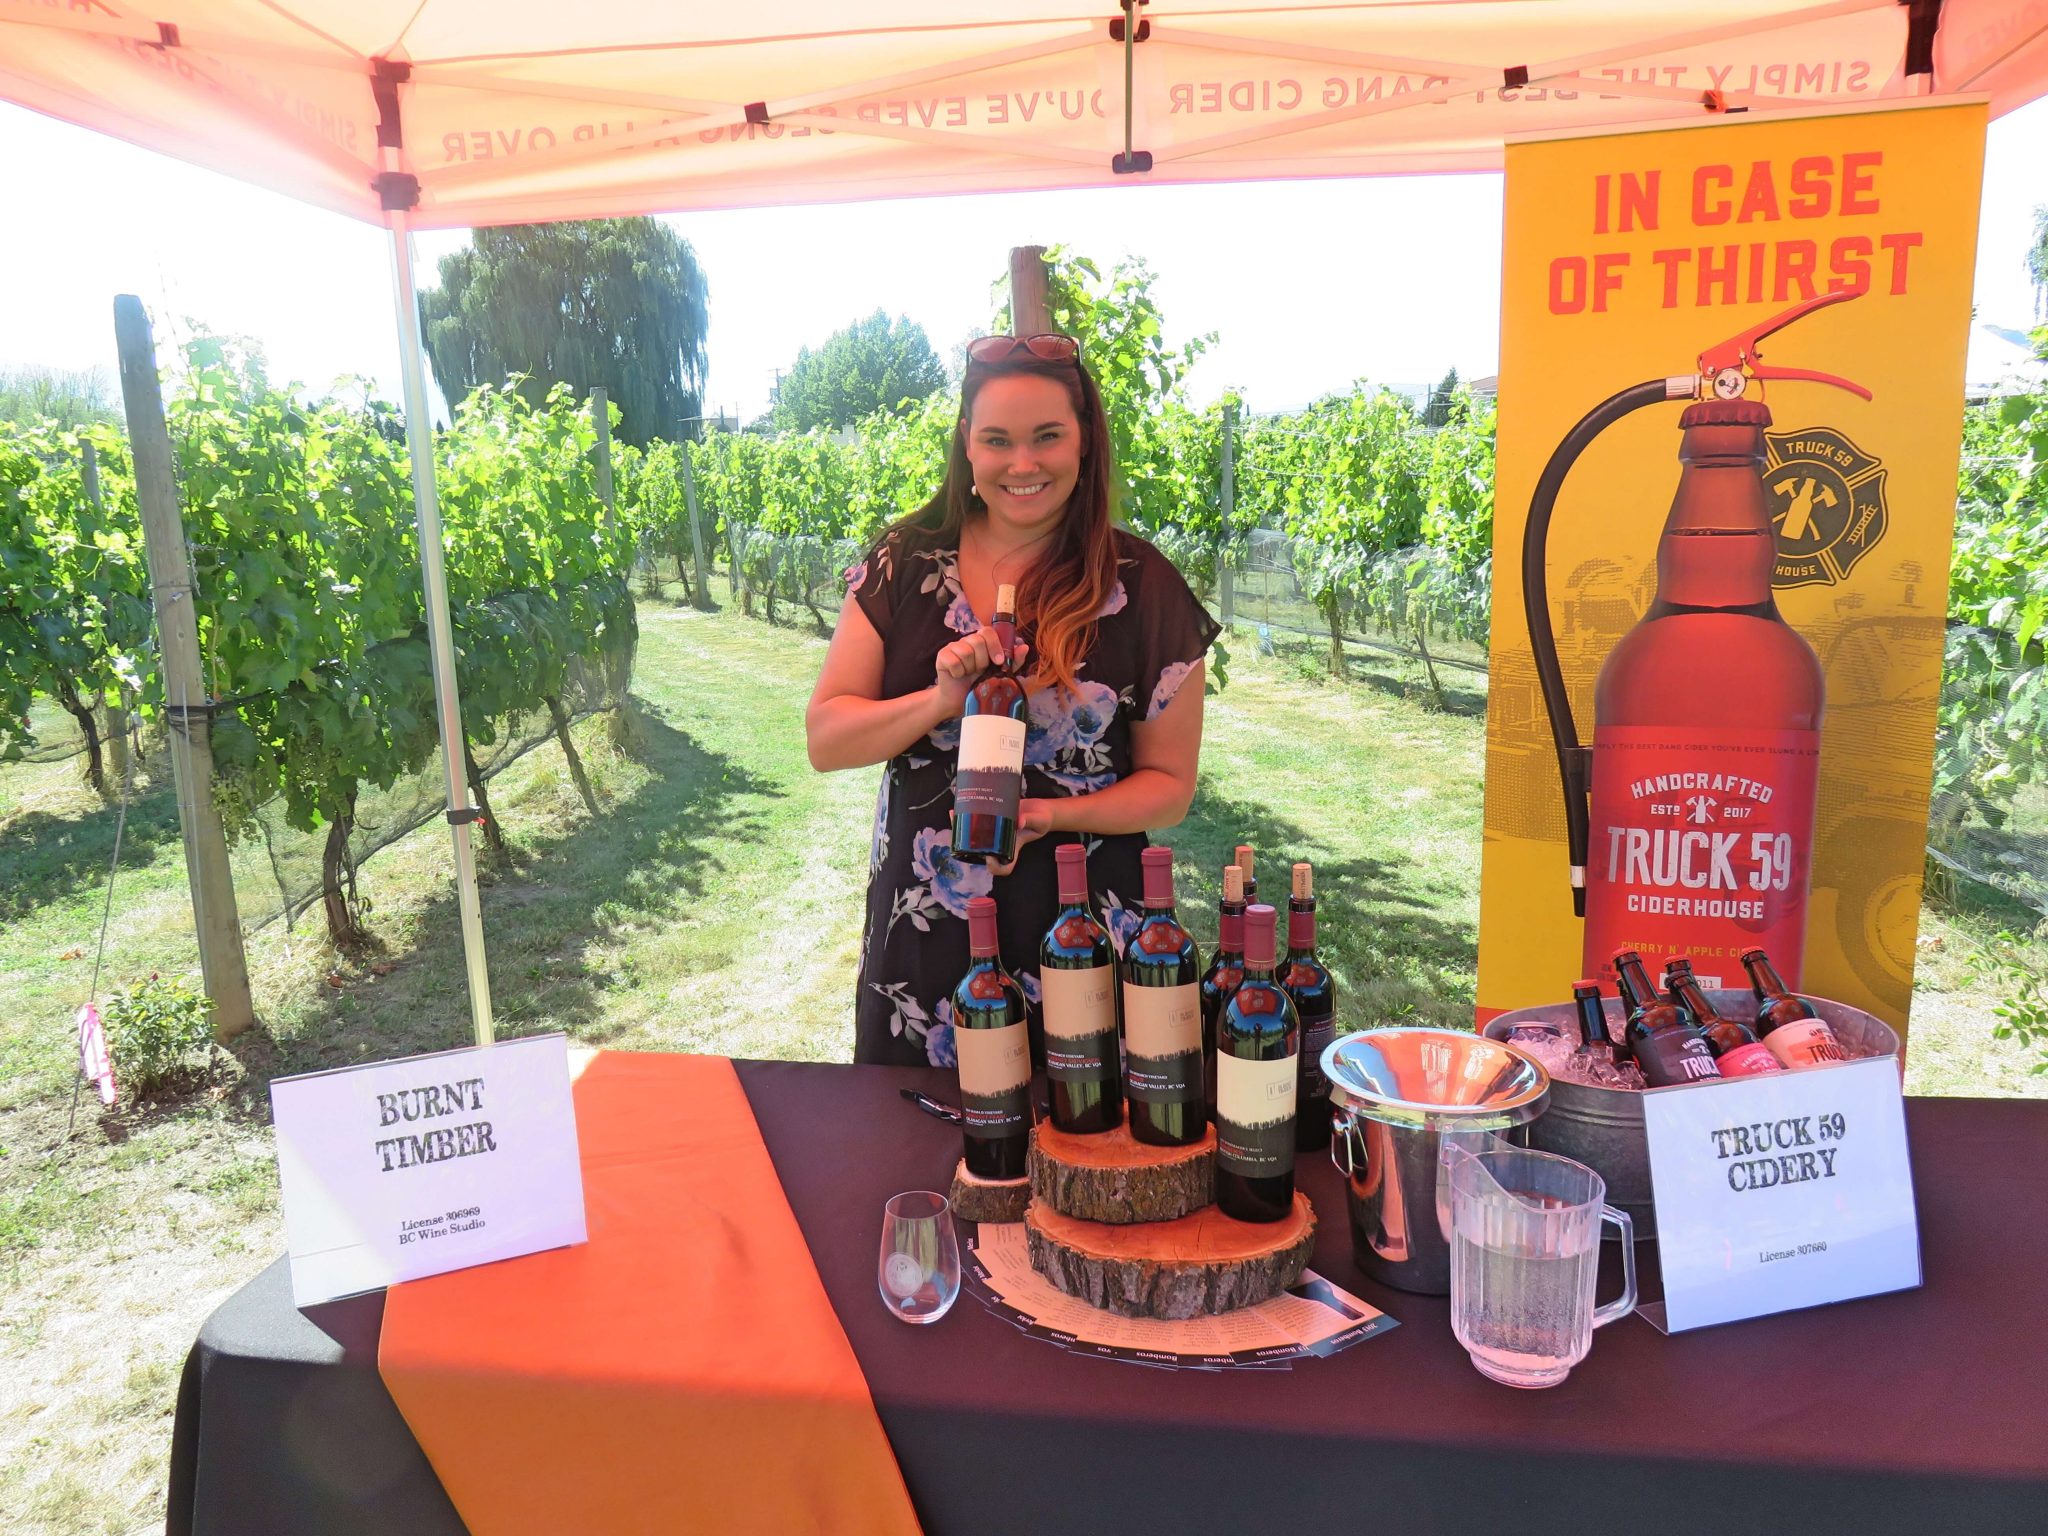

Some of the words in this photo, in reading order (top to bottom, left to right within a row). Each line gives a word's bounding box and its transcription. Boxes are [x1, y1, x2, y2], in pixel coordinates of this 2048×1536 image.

[1593, 170, 1661, 234] IN
[1691, 151, 1883, 227] CASE
[1548, 252, 1631, 316] OF
[1652, 232, 1923, 308] THIRST
[1785, 441, 1836, 458] TRUCK
[1833, 449, 1854, 467] 59
[1775, 564, 1817, 577] HOUSE
[1631, 772, 1774, 804] HANDCRAFTED
[1723, 807, 1752, 818] 2017
[1607, 826, 1741, 890] TRUCK
[1749, 832, 1792, 891] 59
[1627, 894, 1764, 919] CIDERHOUSE
[1621, 941, 1663, 954] CHERRY
[1685, 946, 1723, 957] APPLE
[376, 1077, 485, 1127] BURNT
[375, 1121, 497, 1172] TIMBER
[1711, 1116, 1815, 1159] TRUCK
[1818, 1112, 1846, 1141] 59
[1727, 1147, 1838, 1192] CIDERY
[398, 1231, 416, 1245] BC
[417, 1228, 448, 1241] Wine
[449, 1219, 486, 1234] Studio
[401, 1215, 444, 1232] License
[1759, 1249, 1796, 1263] License
[1136, 1351, 1178, 1361] Bomberos
[1255, 1346, 1297, 1357] Bomberos
